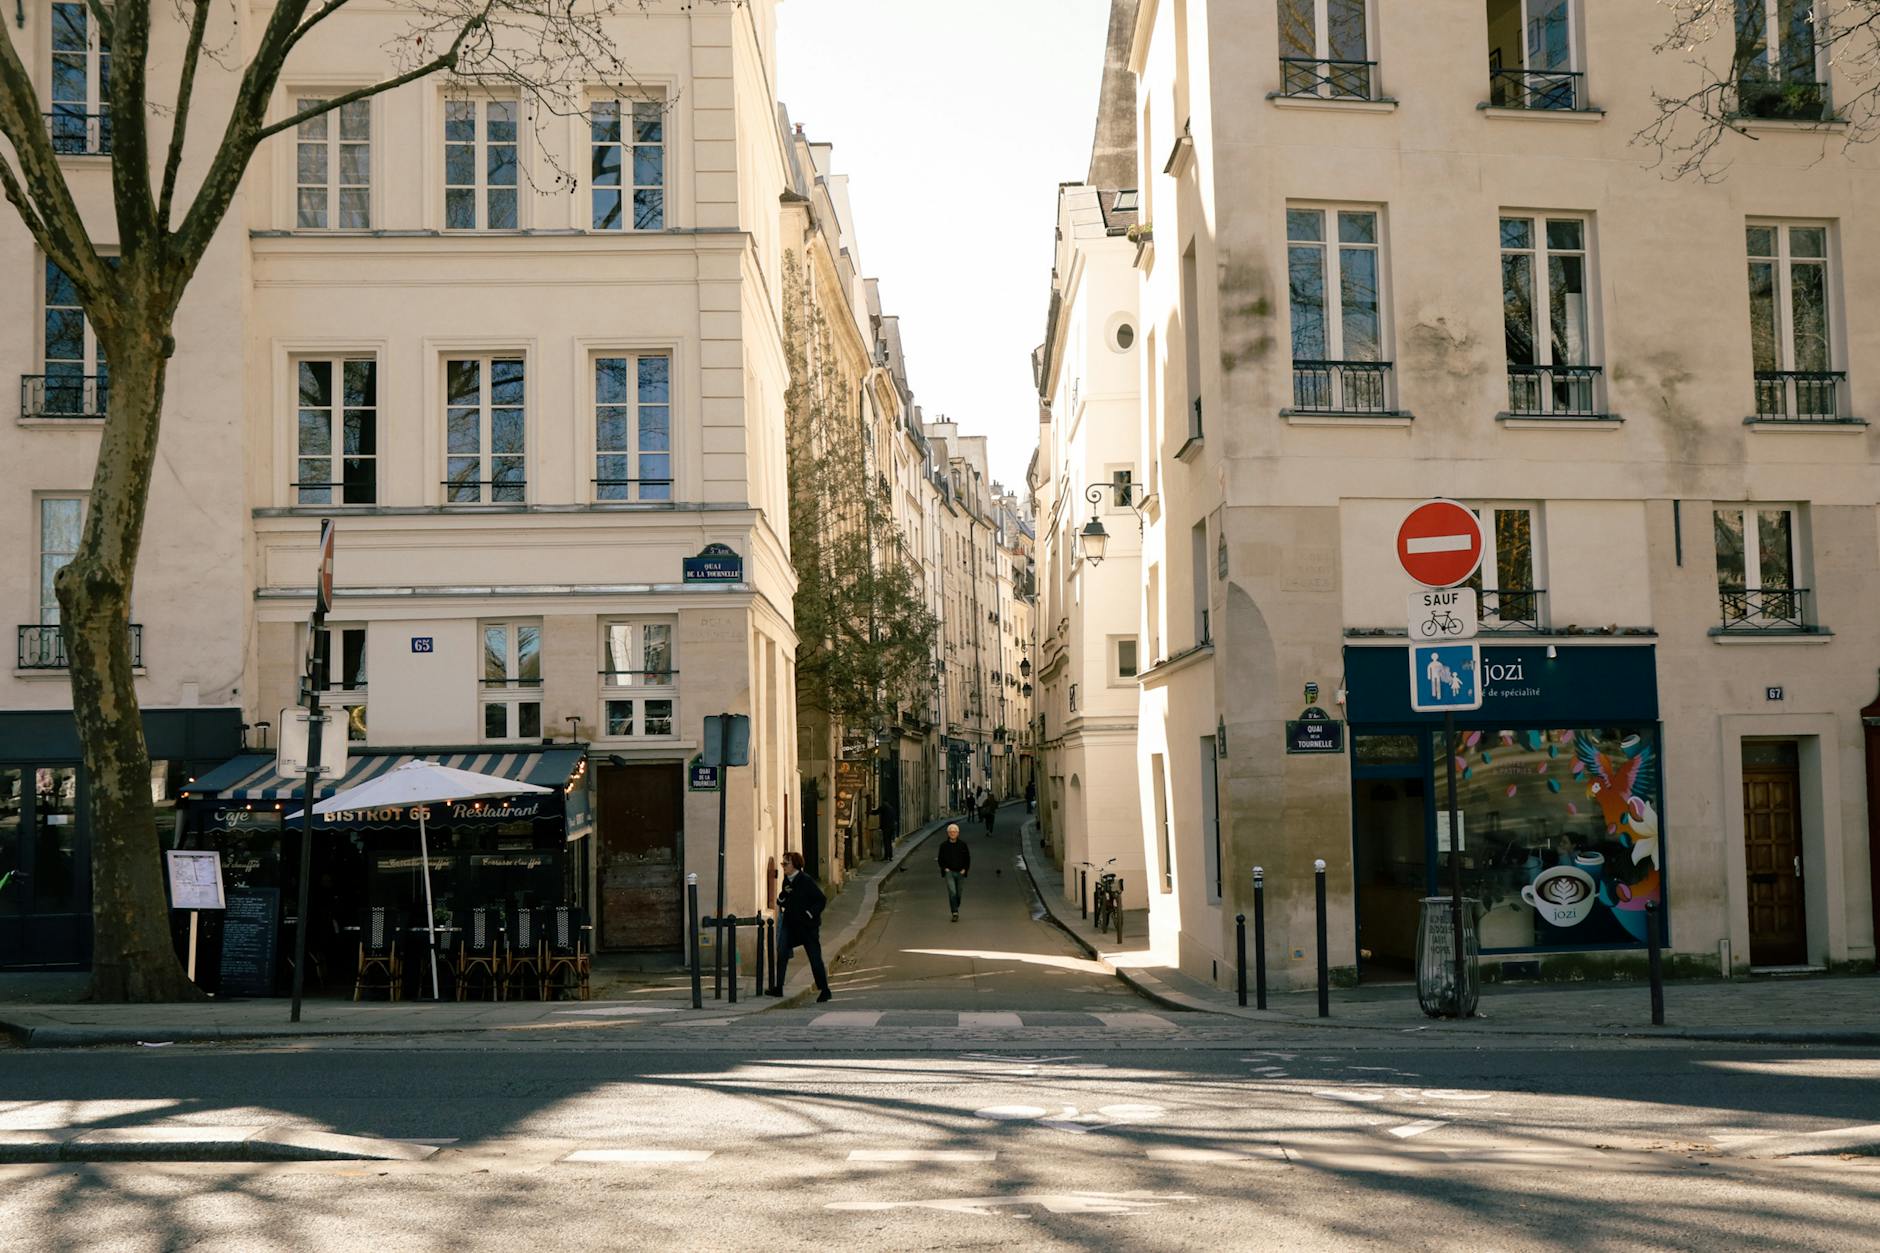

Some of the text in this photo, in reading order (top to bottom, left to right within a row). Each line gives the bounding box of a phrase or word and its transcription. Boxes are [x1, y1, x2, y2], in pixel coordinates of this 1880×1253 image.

[704, 563, 721, 571] QUAI
[687, 570, 738, 578] DE LA TOURNELLE
[1423, 592, 1460, 607] SAUF
[414, 639, 430, 651] 65
[1483, 658, 1524, 687] jozi
[1488, 688, 1498, 697] de
[1500, 687, 1541, 699] spécialité
[1769, 688, 1781, 699] 67
[1307, 725, 1323, 734] QUAI
[1297, 740, 1334, 748] TOURNELLE
[324, 806, 431, 823] BISTROT 65
[452, 801, 539, 820] Restaurant
[214, 807, 250, 828] Café
[1553, 907, 1577, 921] jozi
